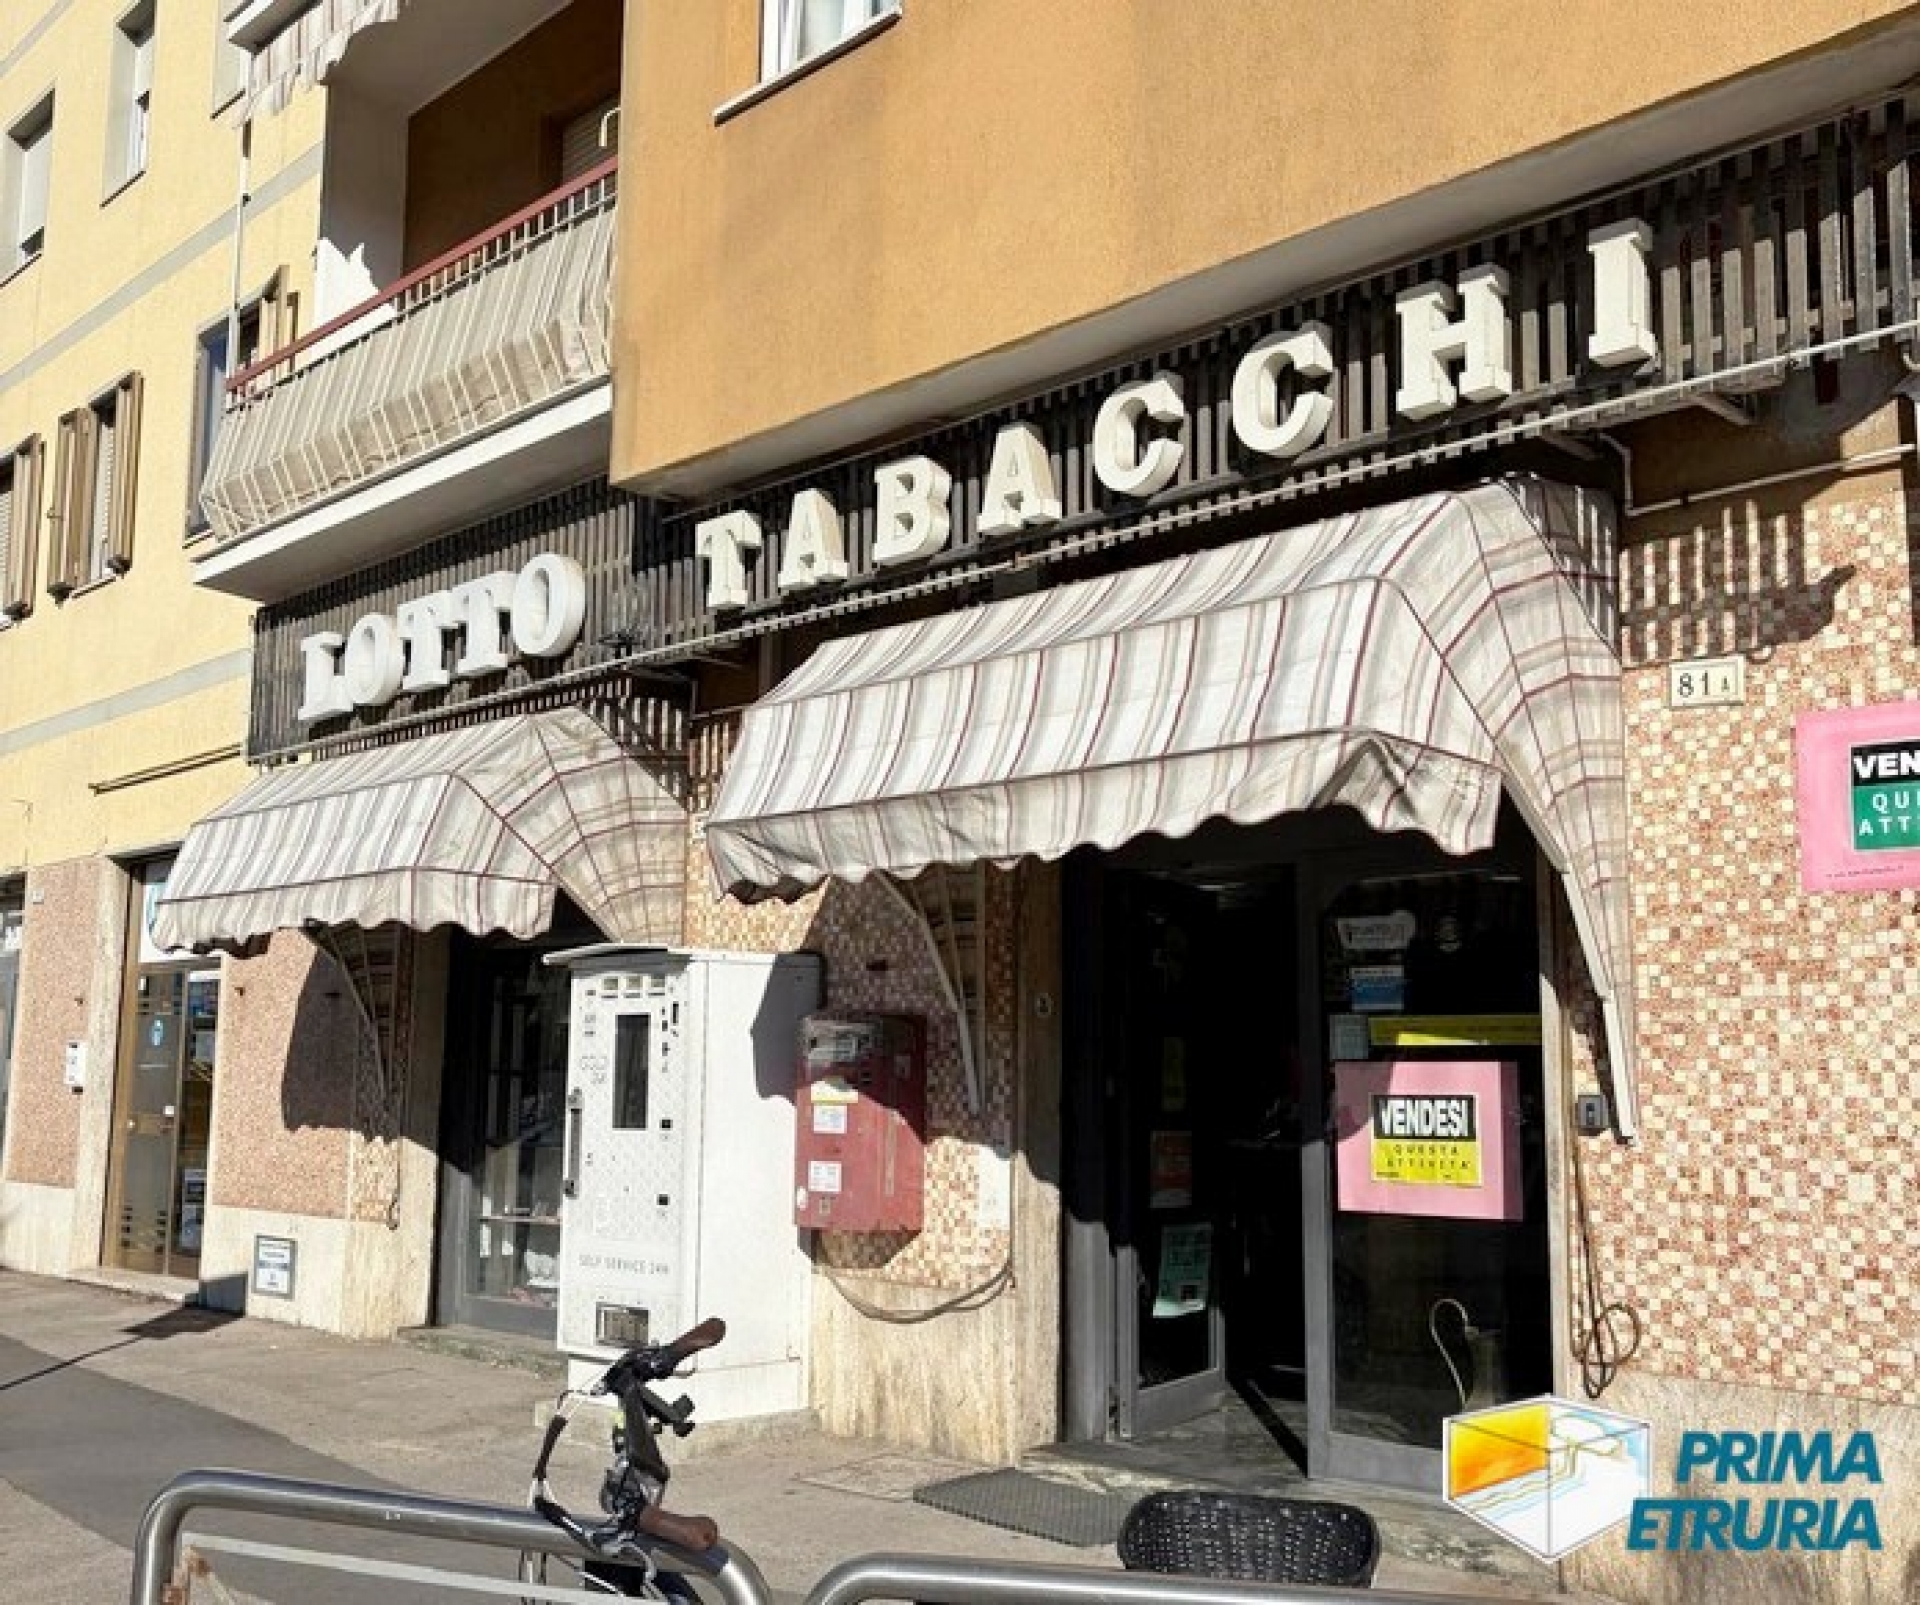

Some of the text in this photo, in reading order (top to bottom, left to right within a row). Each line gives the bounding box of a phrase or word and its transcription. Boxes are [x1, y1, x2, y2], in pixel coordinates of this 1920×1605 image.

[695, 218, 1658, 608] TABACCHI
[298, 553, 587, 720] LOTTO
[1677, 670, 1710, 698] 81
[1872, 790, 1920, 814] QU
[1381, 1098, 1468, 1137] VENDESI
